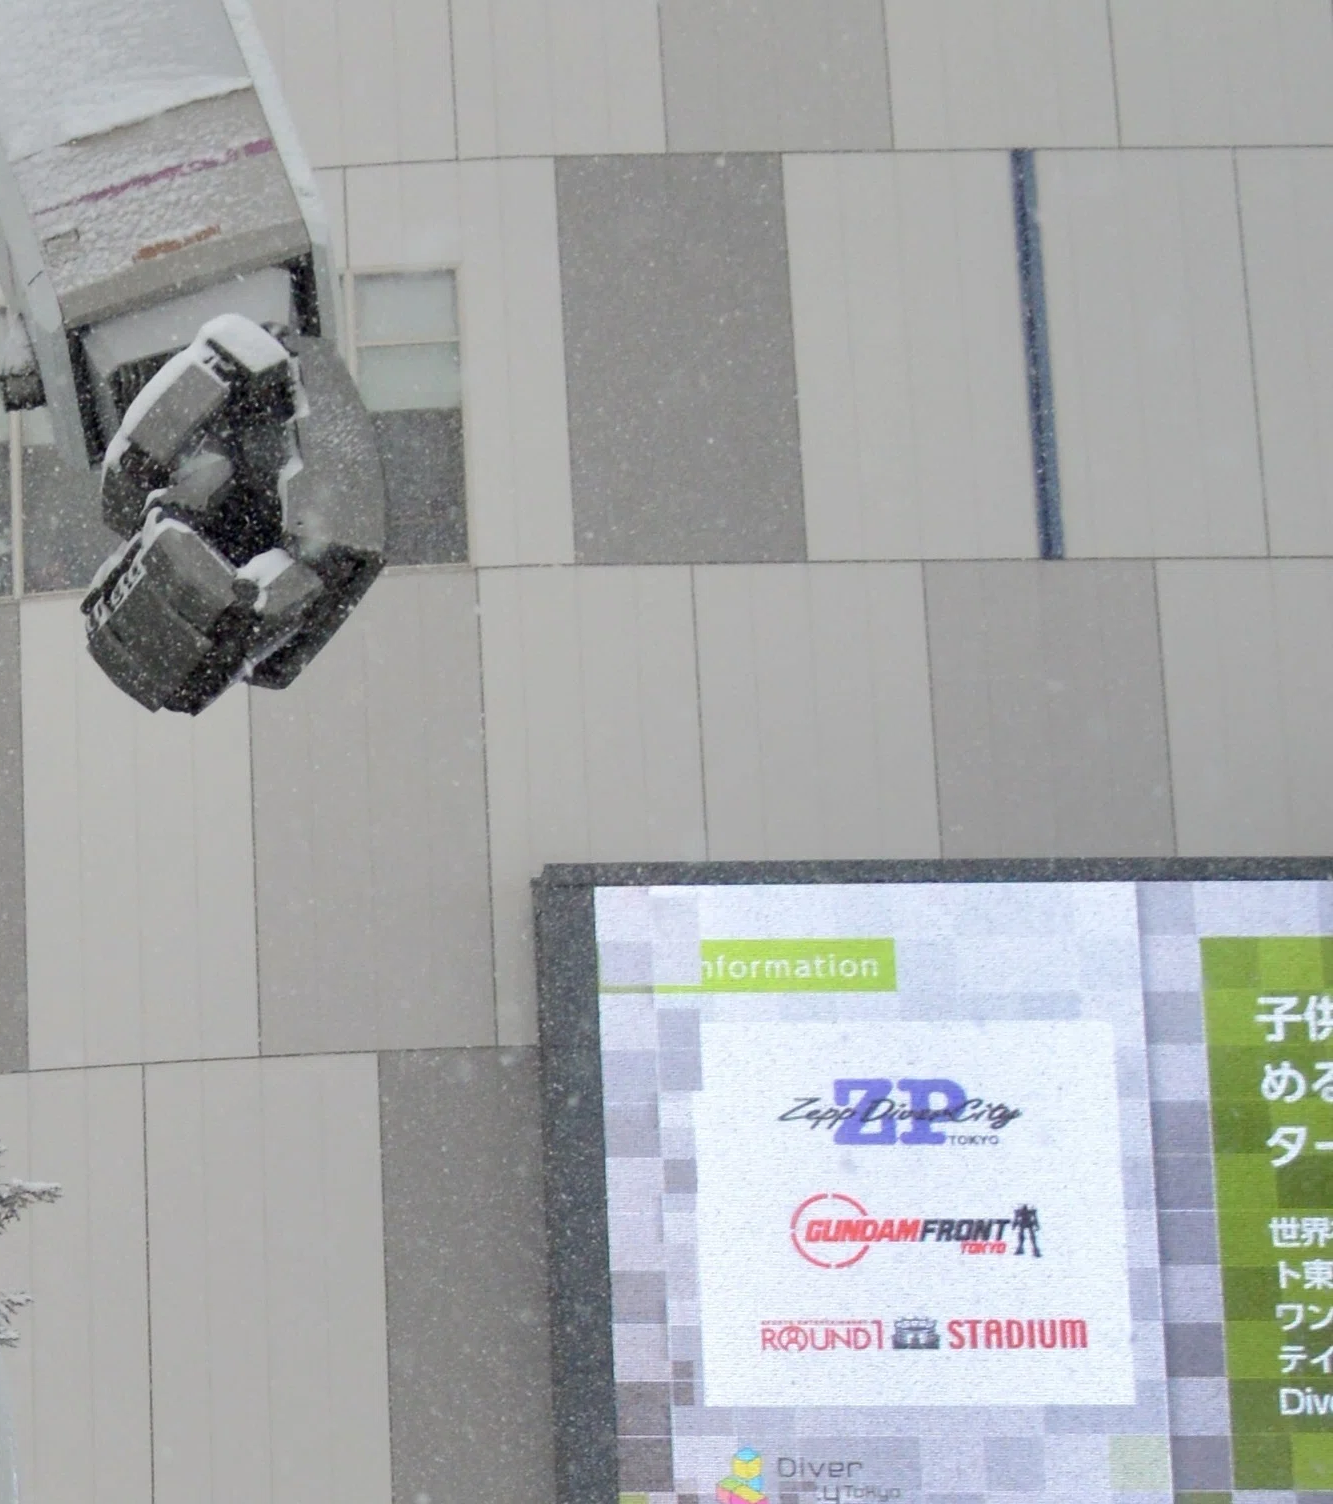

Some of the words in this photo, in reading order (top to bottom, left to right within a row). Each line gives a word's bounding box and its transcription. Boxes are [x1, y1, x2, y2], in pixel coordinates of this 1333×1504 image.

[948, 1134, 1000, 1146] TOKYO
[1269, 1216, 1333, 1248] 世界
[960, 1240, 1007, 1255] TOKYO
[947, 1318, 1088, 1350] STADIUM
